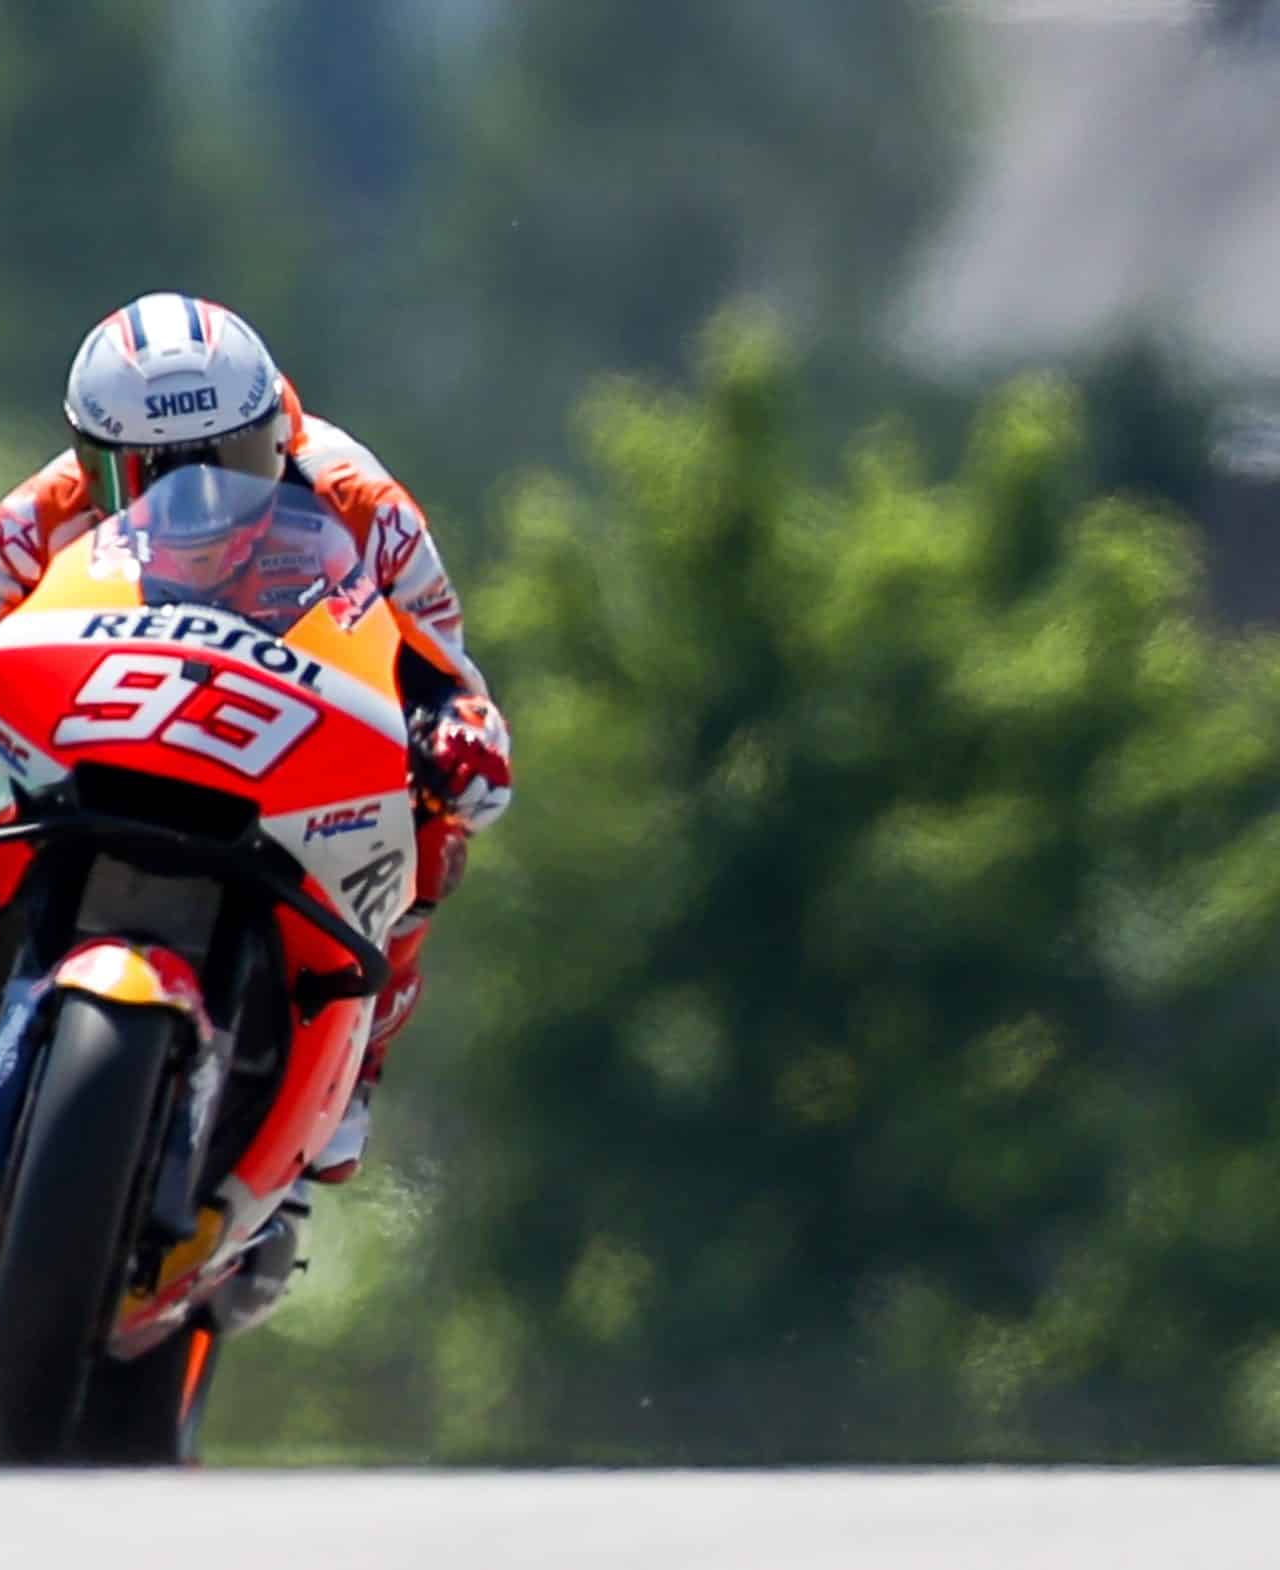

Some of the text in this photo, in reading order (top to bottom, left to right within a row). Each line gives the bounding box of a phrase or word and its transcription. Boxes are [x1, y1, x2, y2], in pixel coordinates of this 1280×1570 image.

[145, 386, 218, 420] SHOEI
[81, 614, 322, 693] REPSOL
[53, 649, 324, 780] 93
[303, 802, 381, 843] HRC
